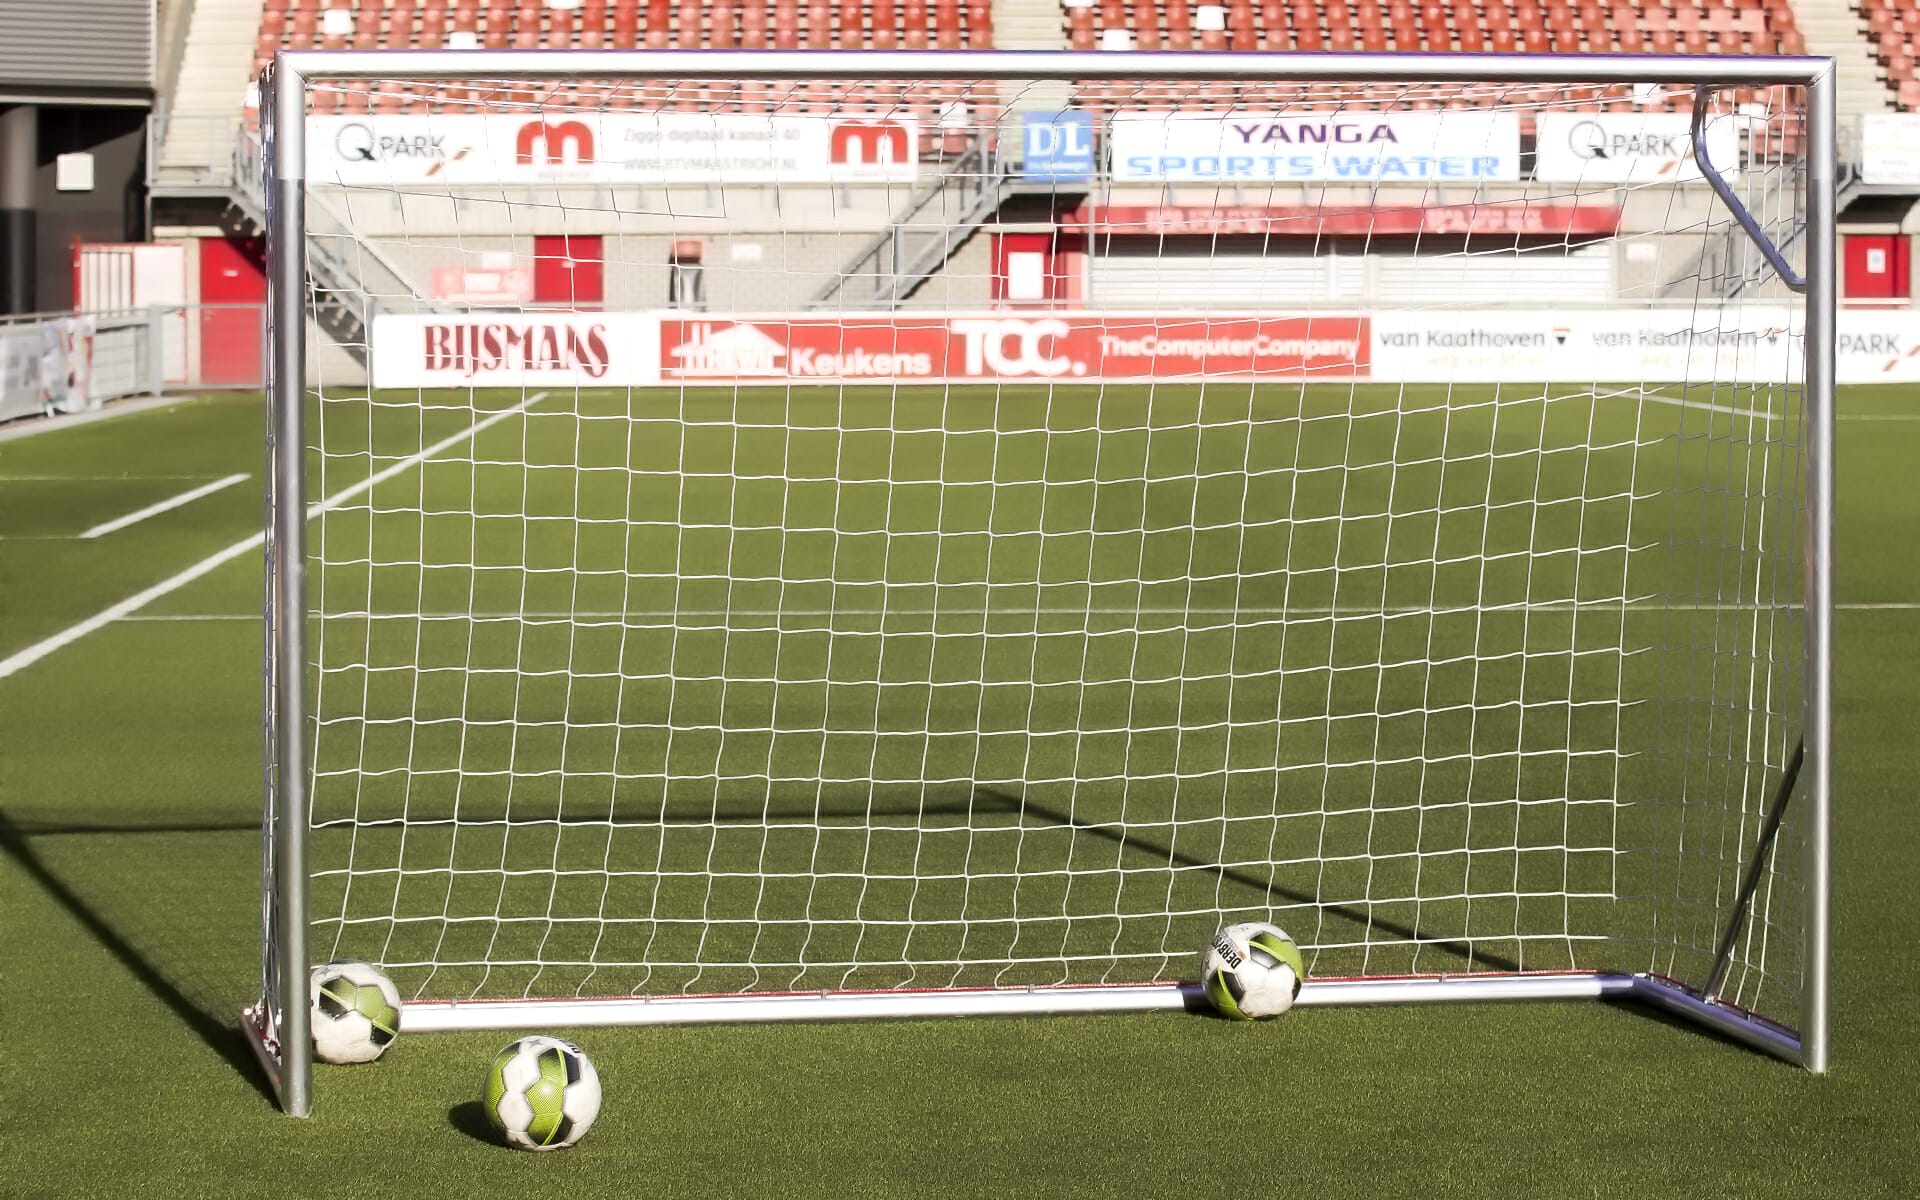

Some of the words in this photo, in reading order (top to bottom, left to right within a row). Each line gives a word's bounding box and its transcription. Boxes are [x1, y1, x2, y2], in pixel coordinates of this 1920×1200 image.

[1232, 124, 1400, 144] YANGA
[1127, 156, 1313, 177] SPORTS
[1333, 154, 1500, 177] WATER
[1098, 335, 1361, 361] TheComputerCompany
[1379, 335, 1420, 348] van
[1427, 328, 1546, 348] Kaathoven
[1592, 333, 1632, 347] van
[1638, 328, 1757, 347] Kaathoven
[424, 324, 609, 378] BIJSMANS
[791, 346, 931, 376] Keukens
